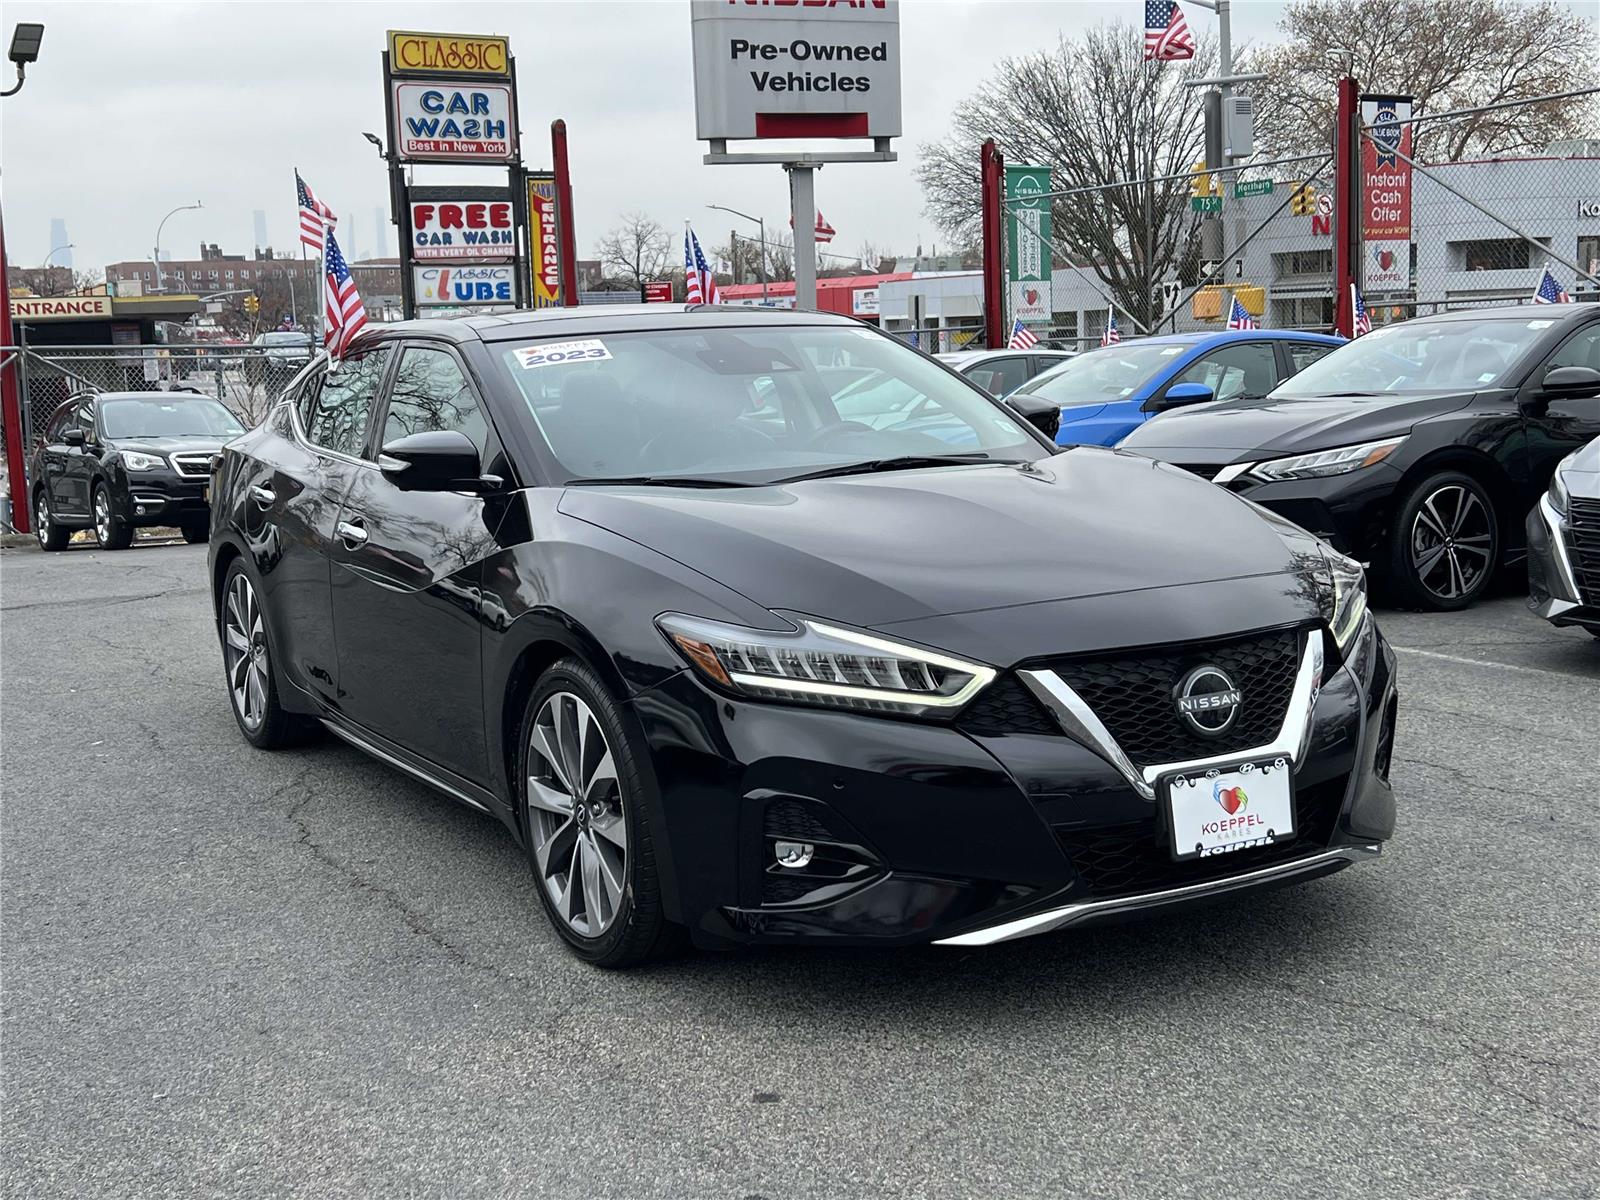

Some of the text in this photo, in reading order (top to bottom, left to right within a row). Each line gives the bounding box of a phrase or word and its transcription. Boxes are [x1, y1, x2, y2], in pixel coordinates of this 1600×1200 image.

[401, 39, 502, 70] CLASSIC
[730, 39, 887, 61] Pre-Owned
[750, 71, 871, 92] Vehicles
[420, 90, 490, 115] CAR
[405, 117, 505, 139] WASH
[409, 140, 505, 153] Best in New York
[1237, 181, 1270, 193] Northern
[1366, 172, 1407, 187] Instant
[1200, 198, 1211, 211] 75
[1371, 189, 1401, 204] Cash
[413, 204, 511, 230] FREE
[1371, 206, 1402, 221] Offer
[416, 230, 512, 246] CAR WASH
[541, 202, 559, 285] ENTRANCE
[416, 246, 513, 257] WITH EVERY OIL CHANGE
[1367, 273, 1404, 282] KOEPPEL
[525, 348, 607, 367] 2023
[1180, 691, 1240, 711] NISSAN
[1201, 814, 1265, 836] KOEPPEL
[1217, 828, 1252, 841] KARES
[1199, 836, 1274, 858] KOEPPEL
